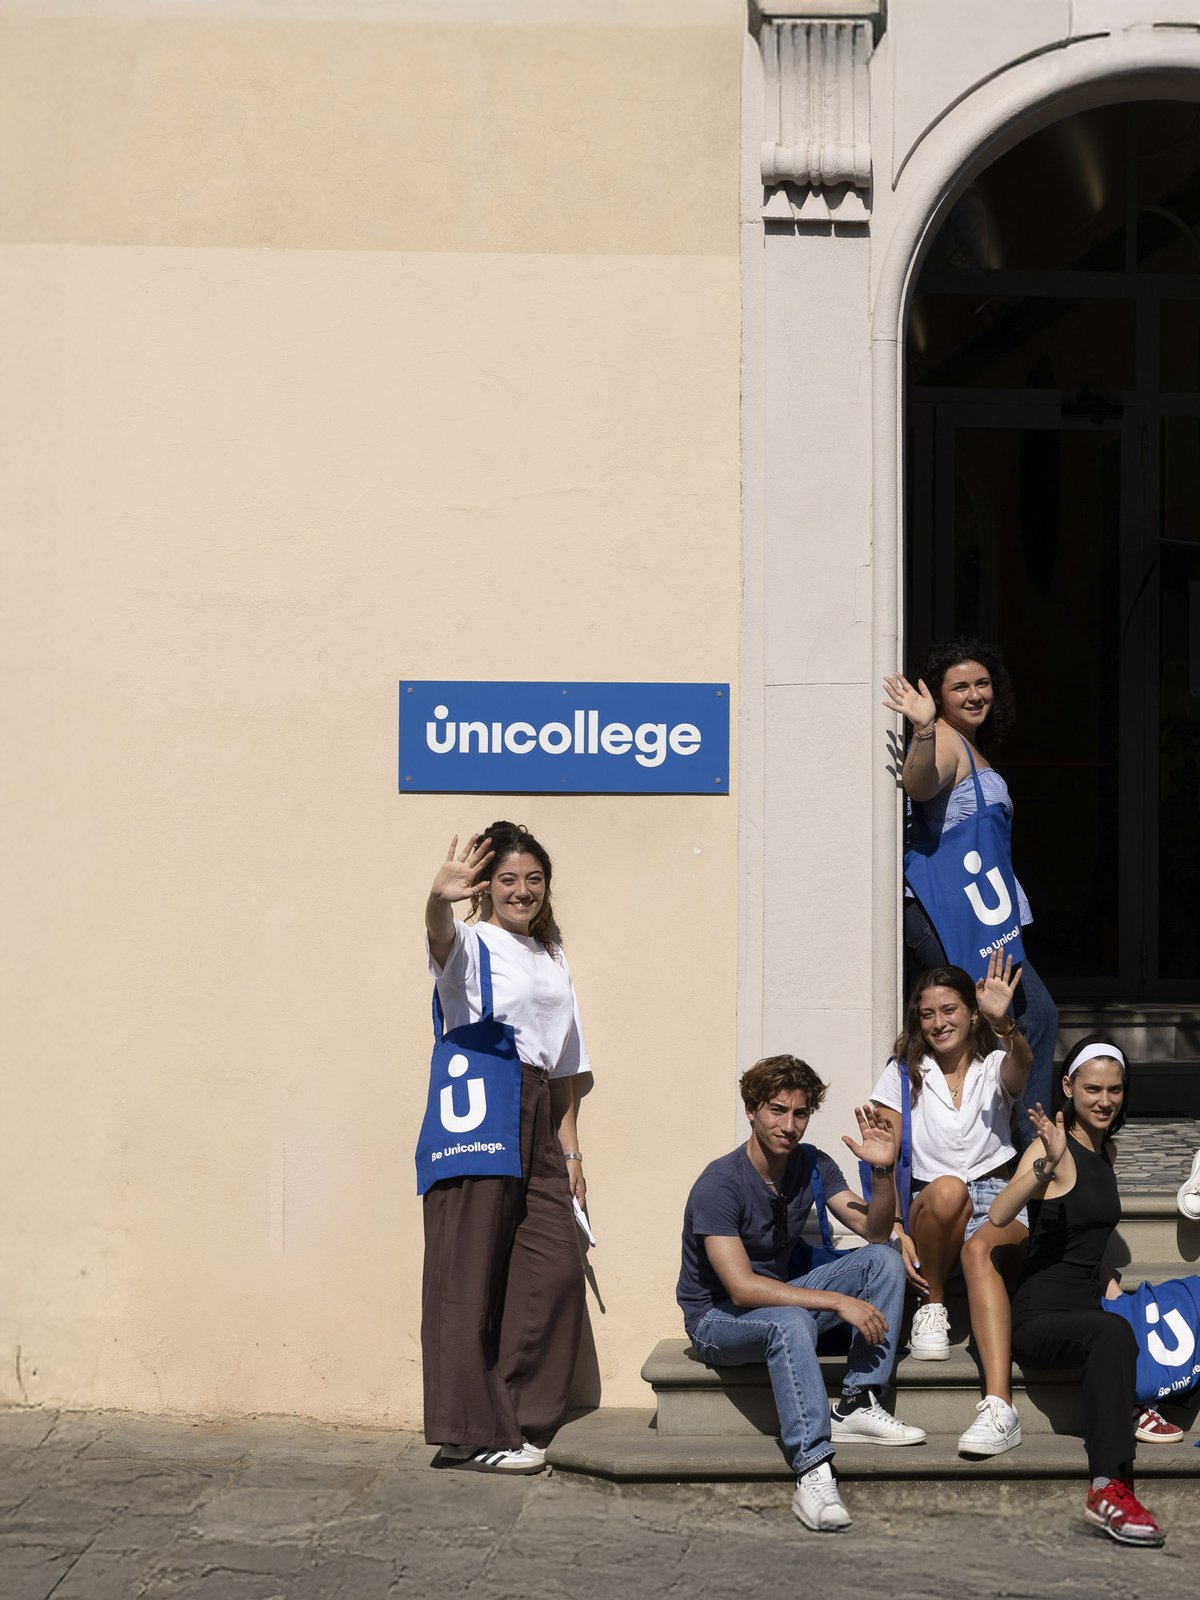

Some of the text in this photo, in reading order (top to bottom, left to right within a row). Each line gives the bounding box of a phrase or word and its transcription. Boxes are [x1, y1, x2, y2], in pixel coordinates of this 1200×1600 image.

[979, 946, 993, 959] Be
[431, 1141, 506, 1163] Be Unicollege.
[1157, 1386, 1172, 1397] Be
